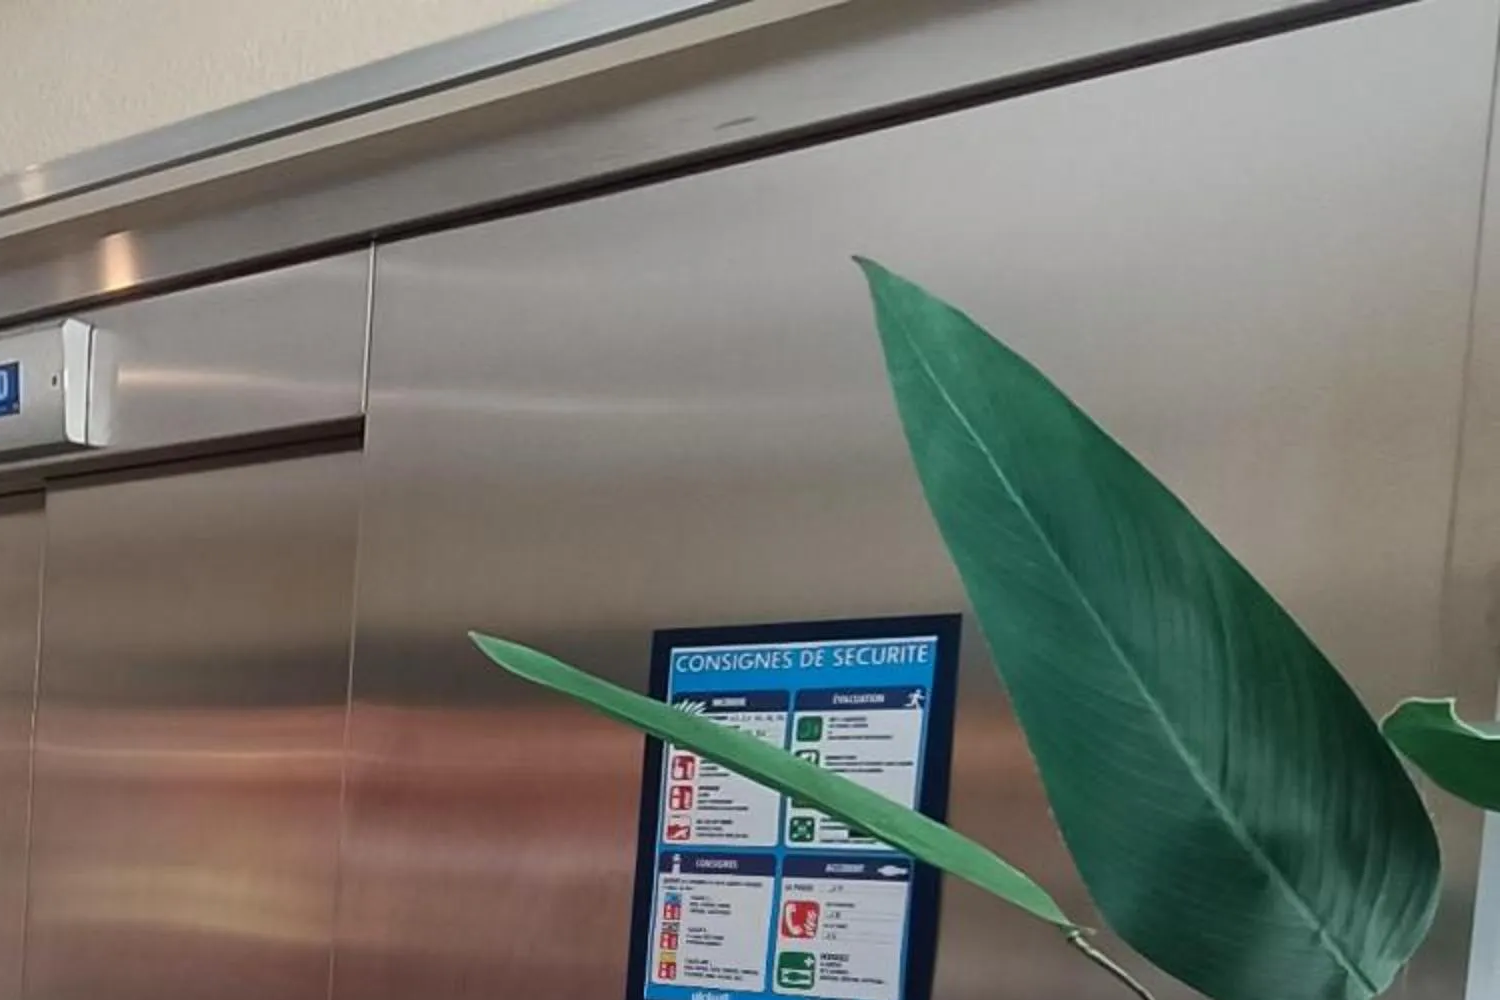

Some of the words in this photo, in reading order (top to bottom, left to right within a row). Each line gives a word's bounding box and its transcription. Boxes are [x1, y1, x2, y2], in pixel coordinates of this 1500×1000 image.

[675, 650, 794, 673] CONSIGNES
[799, 648, 825, 669] DE
[832, 644, 929, 667] SECURITE
